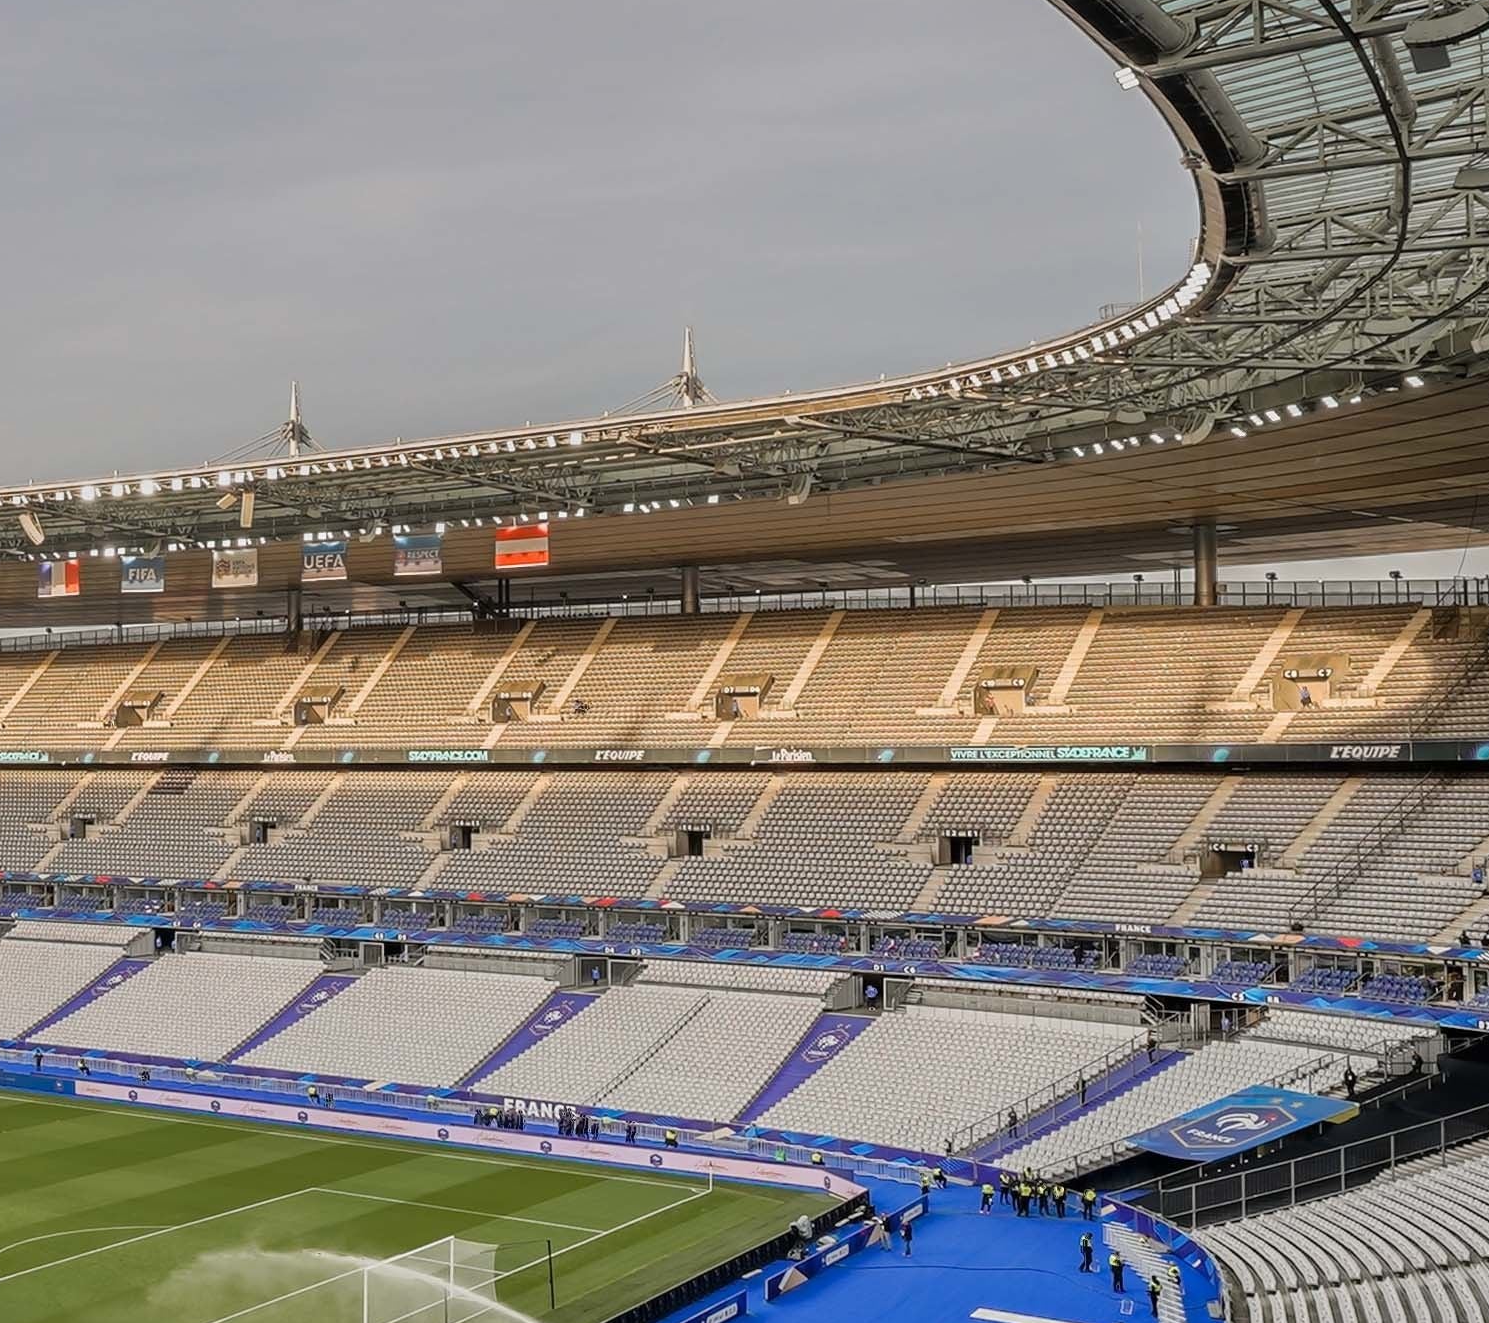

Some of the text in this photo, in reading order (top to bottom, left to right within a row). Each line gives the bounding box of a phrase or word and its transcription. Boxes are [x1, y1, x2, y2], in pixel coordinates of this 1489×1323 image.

[406, 550, 440, 559] RESPECT
[303, 554, 344, 570] UEFA
[128, 568, 156, 581] FIFA
[1318, 668, 1332, 677] C7
[950, 747, 1130, 760] VIVRE L'EXCEPTIONNEL STADEFRANCE
[1114, 923, 1151, 933] FRANCE
